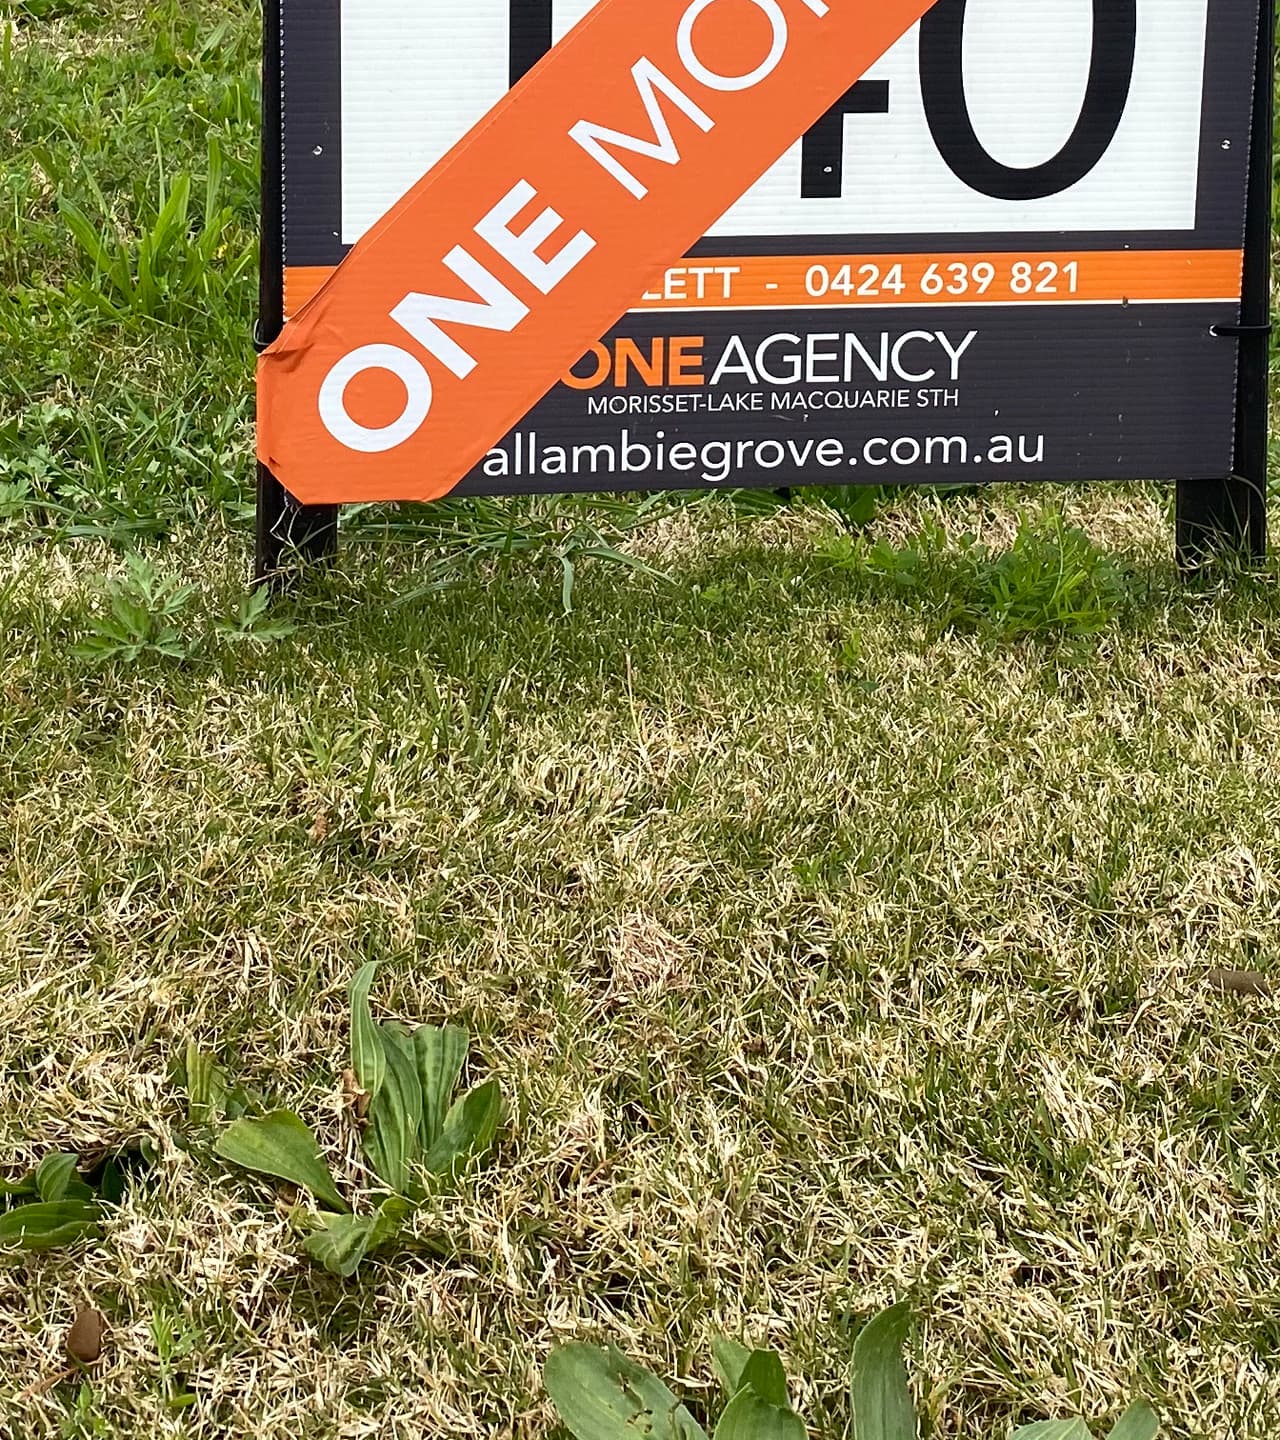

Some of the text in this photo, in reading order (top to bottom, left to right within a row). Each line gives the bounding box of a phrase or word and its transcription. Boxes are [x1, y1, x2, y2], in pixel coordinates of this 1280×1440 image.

[804, 263, 906, 297] 0424
[920, 262, 995, 295] 639
[1009, 260, 1079, 294] 821
[318, 178, 597, 454] ONE
[588, 388, 959, 415] MORISSET-LAKE MACQUARIE STH
[482, 428, 1045, 482] allambiegrove.com.au
